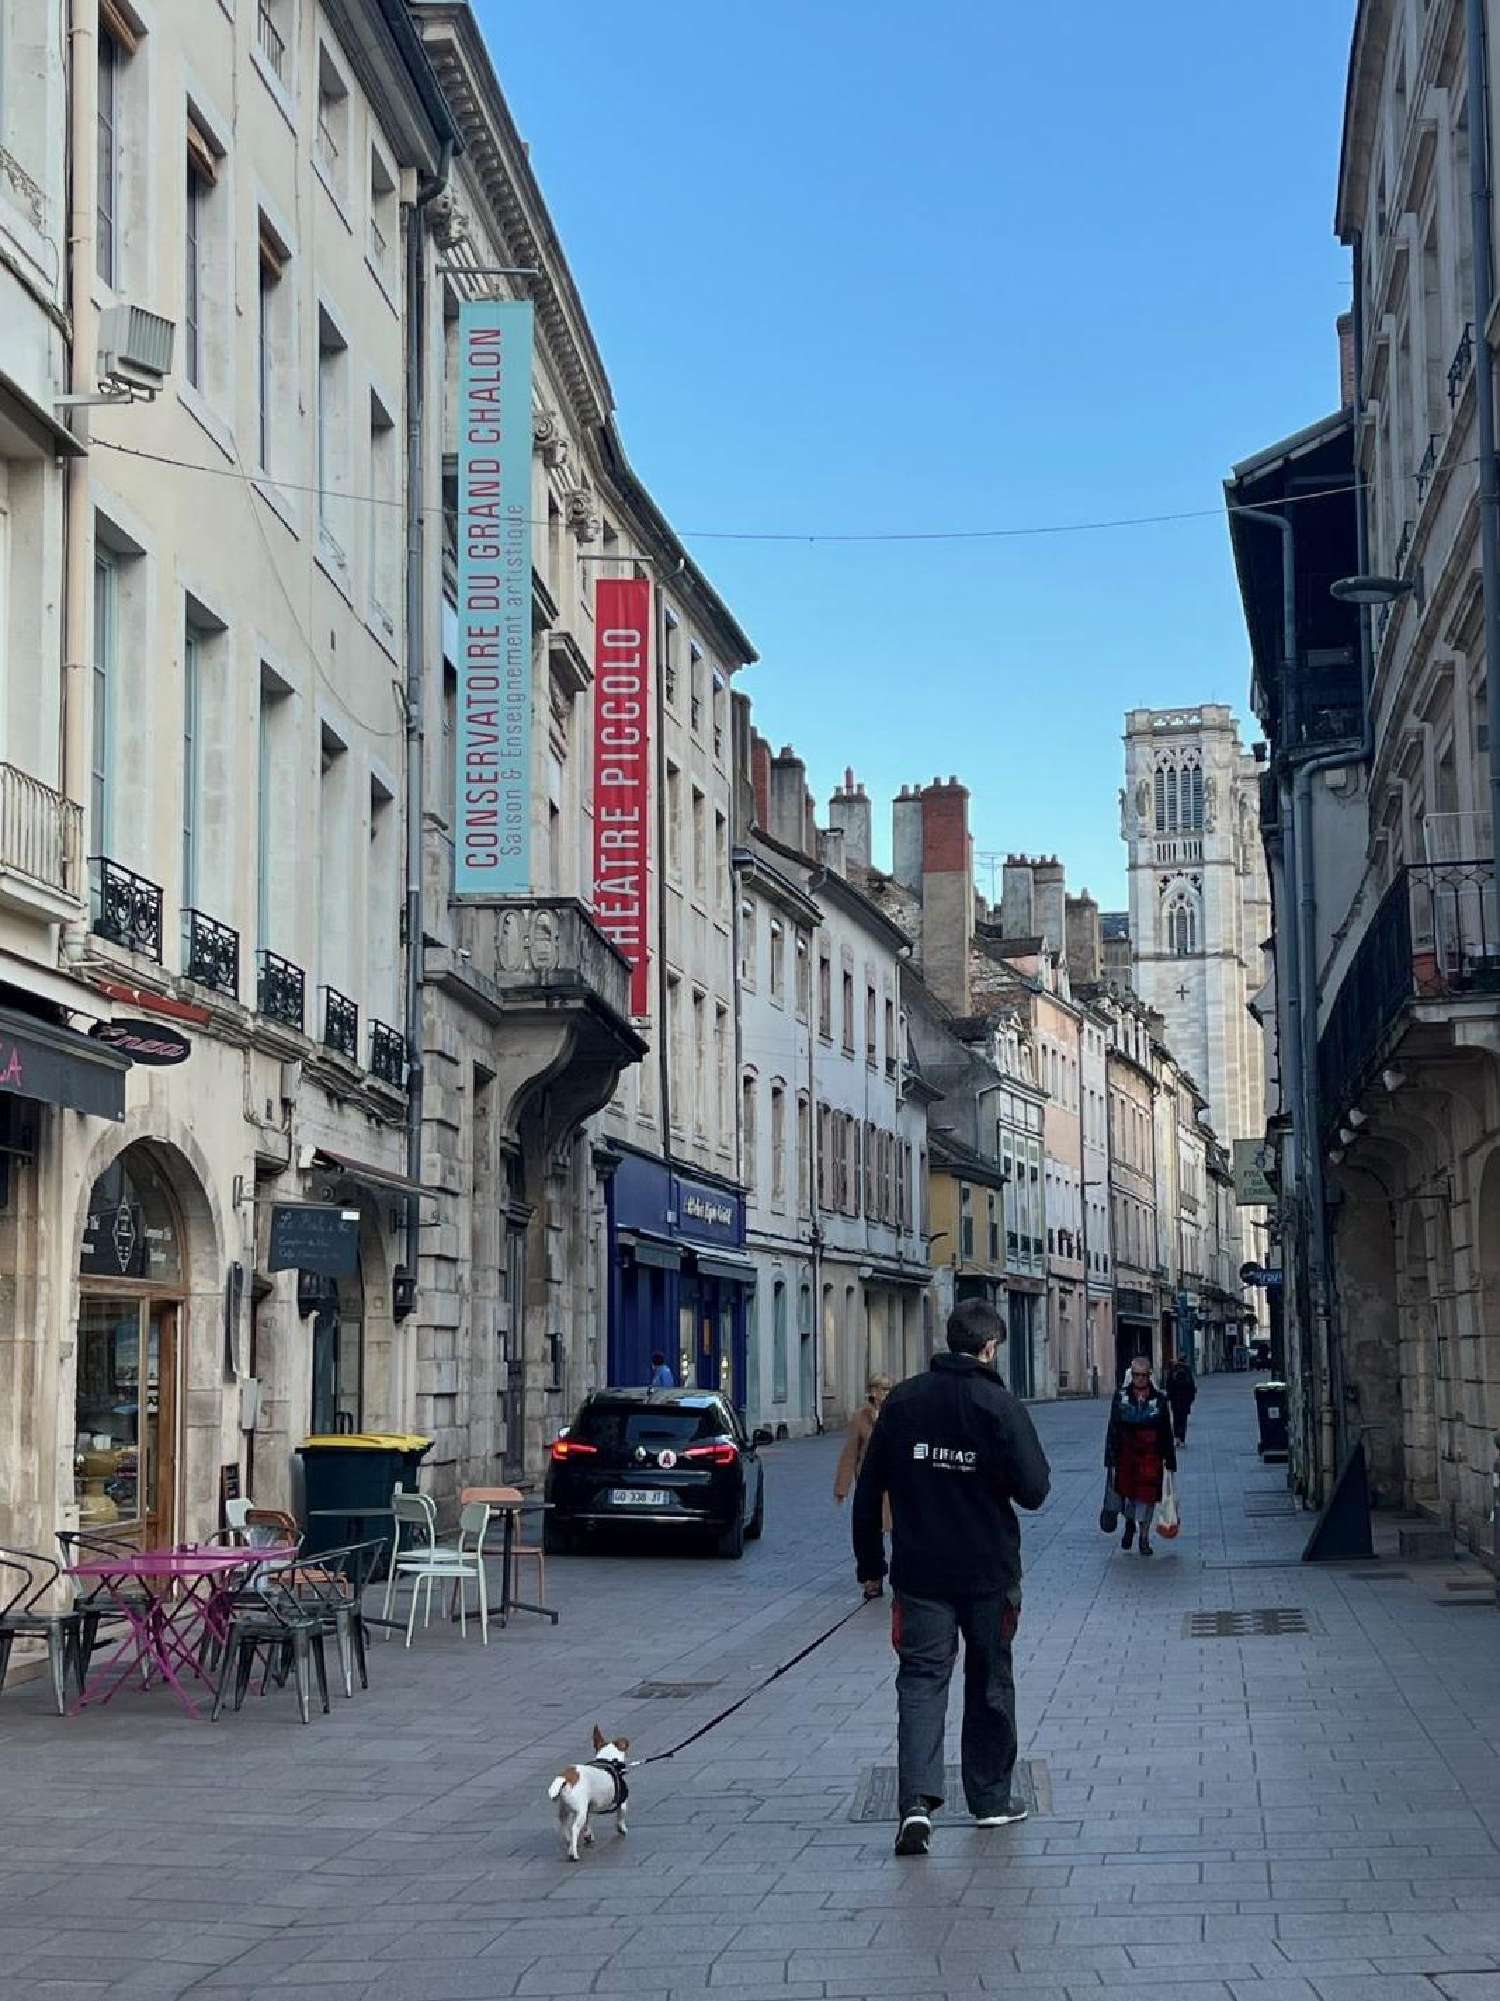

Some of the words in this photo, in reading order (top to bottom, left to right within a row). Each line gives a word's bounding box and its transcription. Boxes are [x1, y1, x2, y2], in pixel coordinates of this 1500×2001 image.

[468, 329, 502, 442] CHALON
[467, 460, 501, 560] GRAND
[503, 504, 528, 607] artistique
[467, 575, 501, 610] DU
[501, 615, 526, 758] Enseignement
[600, 628, 641, 786] PICCOLO
[465, 625, 500, 867] CONSERVATOIRE
[500, 768, 522, 780] &
[500, 789, 523, 856] Saison
[594, 806, 640, 963] HÉÂTRE
